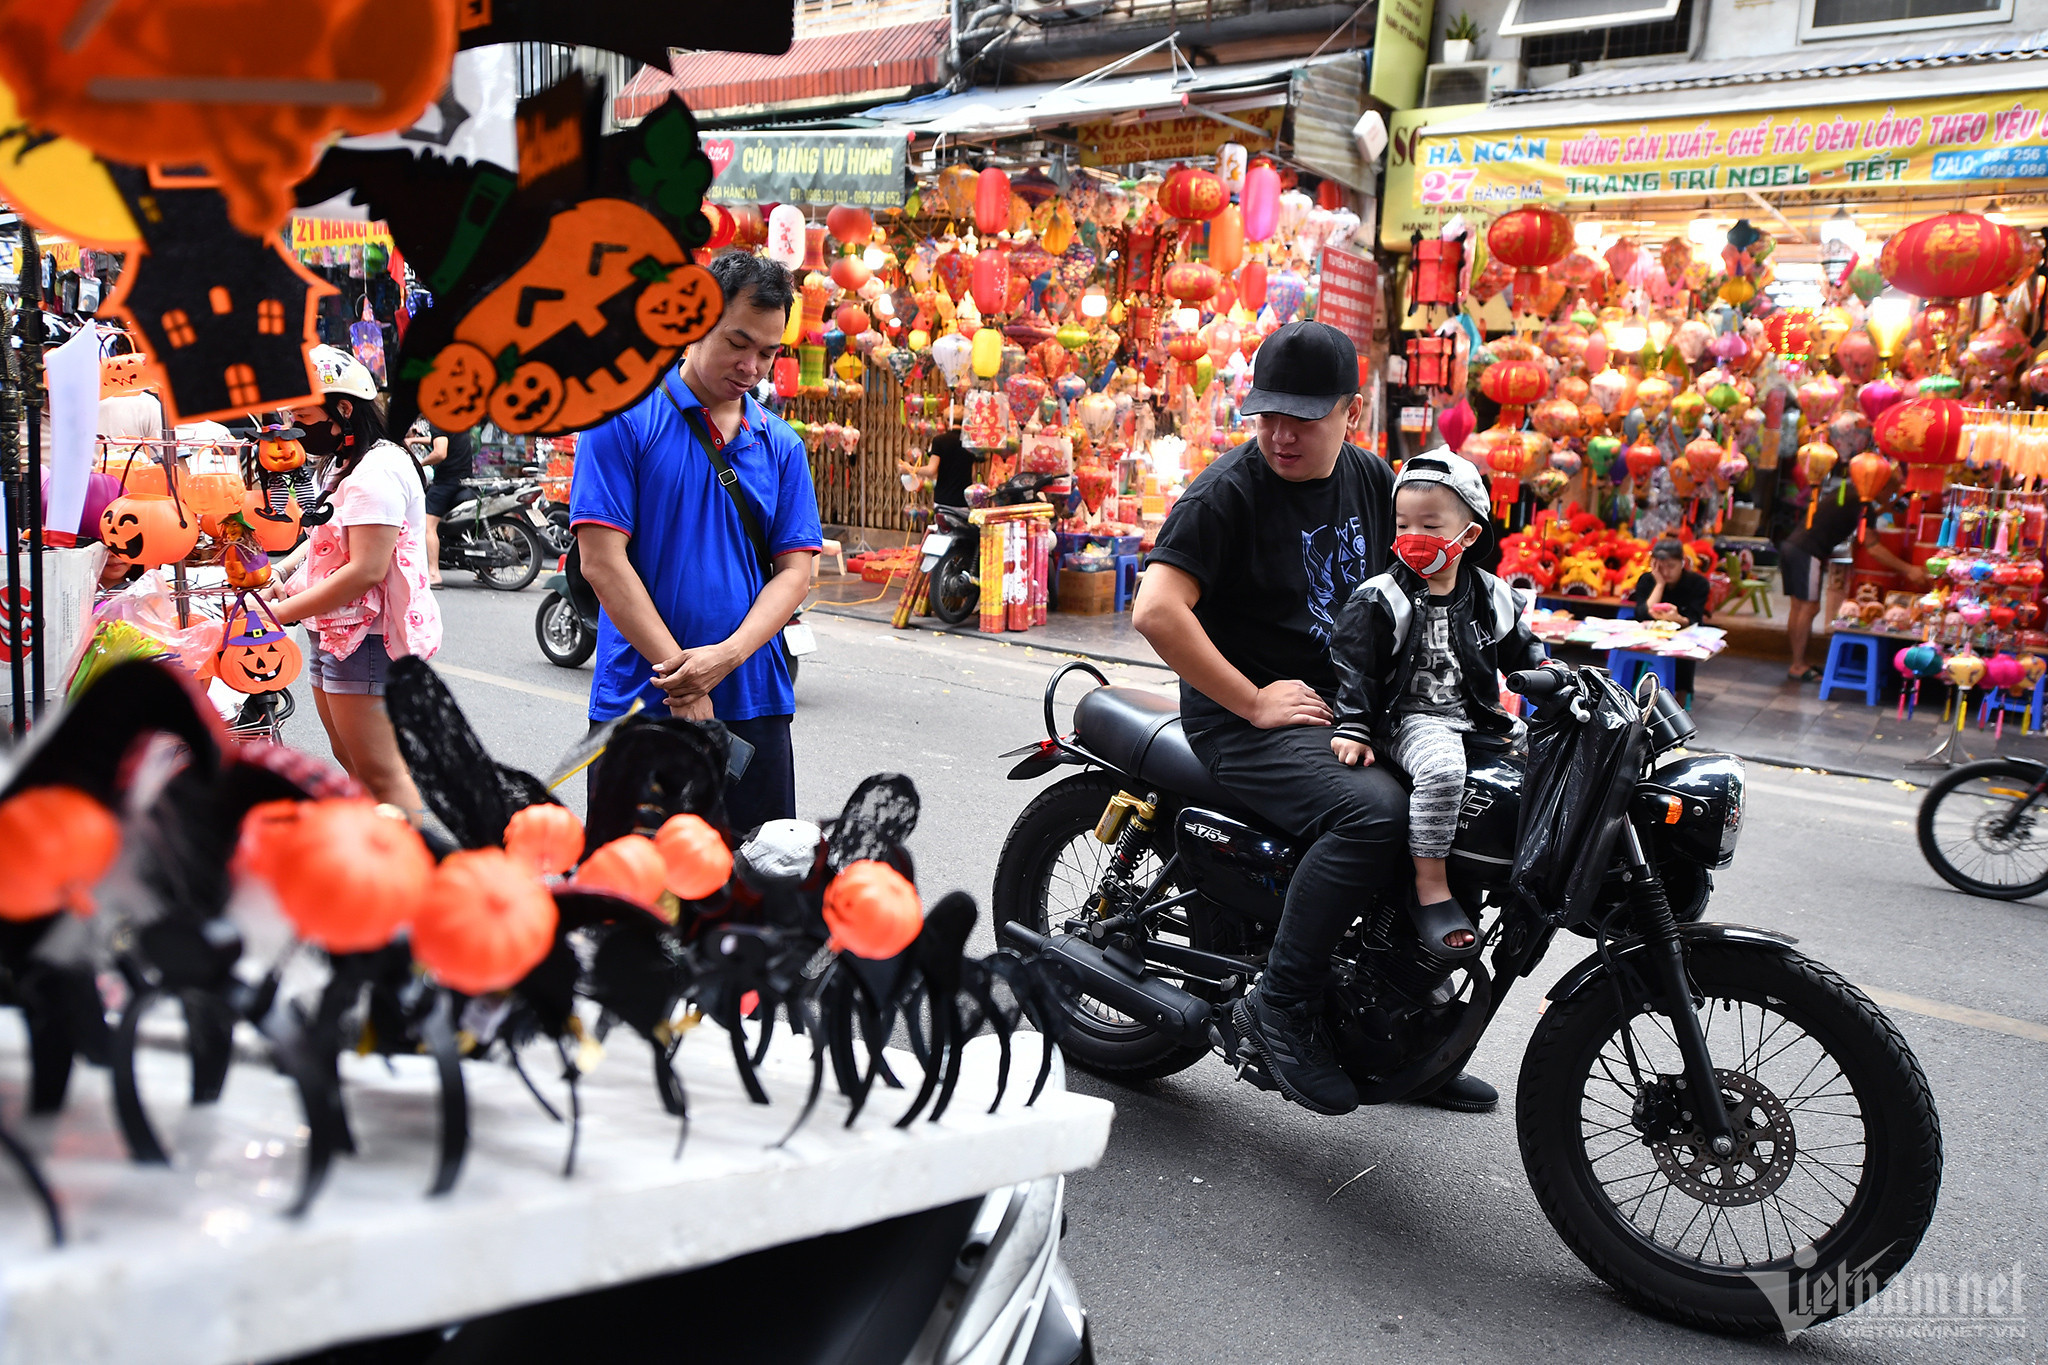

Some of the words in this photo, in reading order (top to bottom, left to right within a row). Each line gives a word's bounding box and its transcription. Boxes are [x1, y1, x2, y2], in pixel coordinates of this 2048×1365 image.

[1773, 118, 1810, 152] TÁC
[1815, 116, 1860, 151] ĐÈN
[1930, 113, 1987, 144] THEO
[1994, 103, 2039, 141] YÊU
[742, 139, 773, 174] CỬA
[776, 142, 820, 175] HÀNG
[823, 143, 846, 175] VŨ
[847, 142, 894, 176] HÙNG
[1429, 138, 1463, 165] HÀ
[1474, 135, 1547, 163] NGÂN
[1423, 171, 1476, 203] 27
[1474, 181, 1516, 200] HÀNG
[1566, 171, 1659, 195] TRANG
[1671, 163, 1719, 190] TRÍ
[1728, 164, 1809, 188] NOEL
[1845, 151, 1908, 182] TẾT
[296, 218, 314, 242] 21
[1192, 823, 1221, 842] 175
